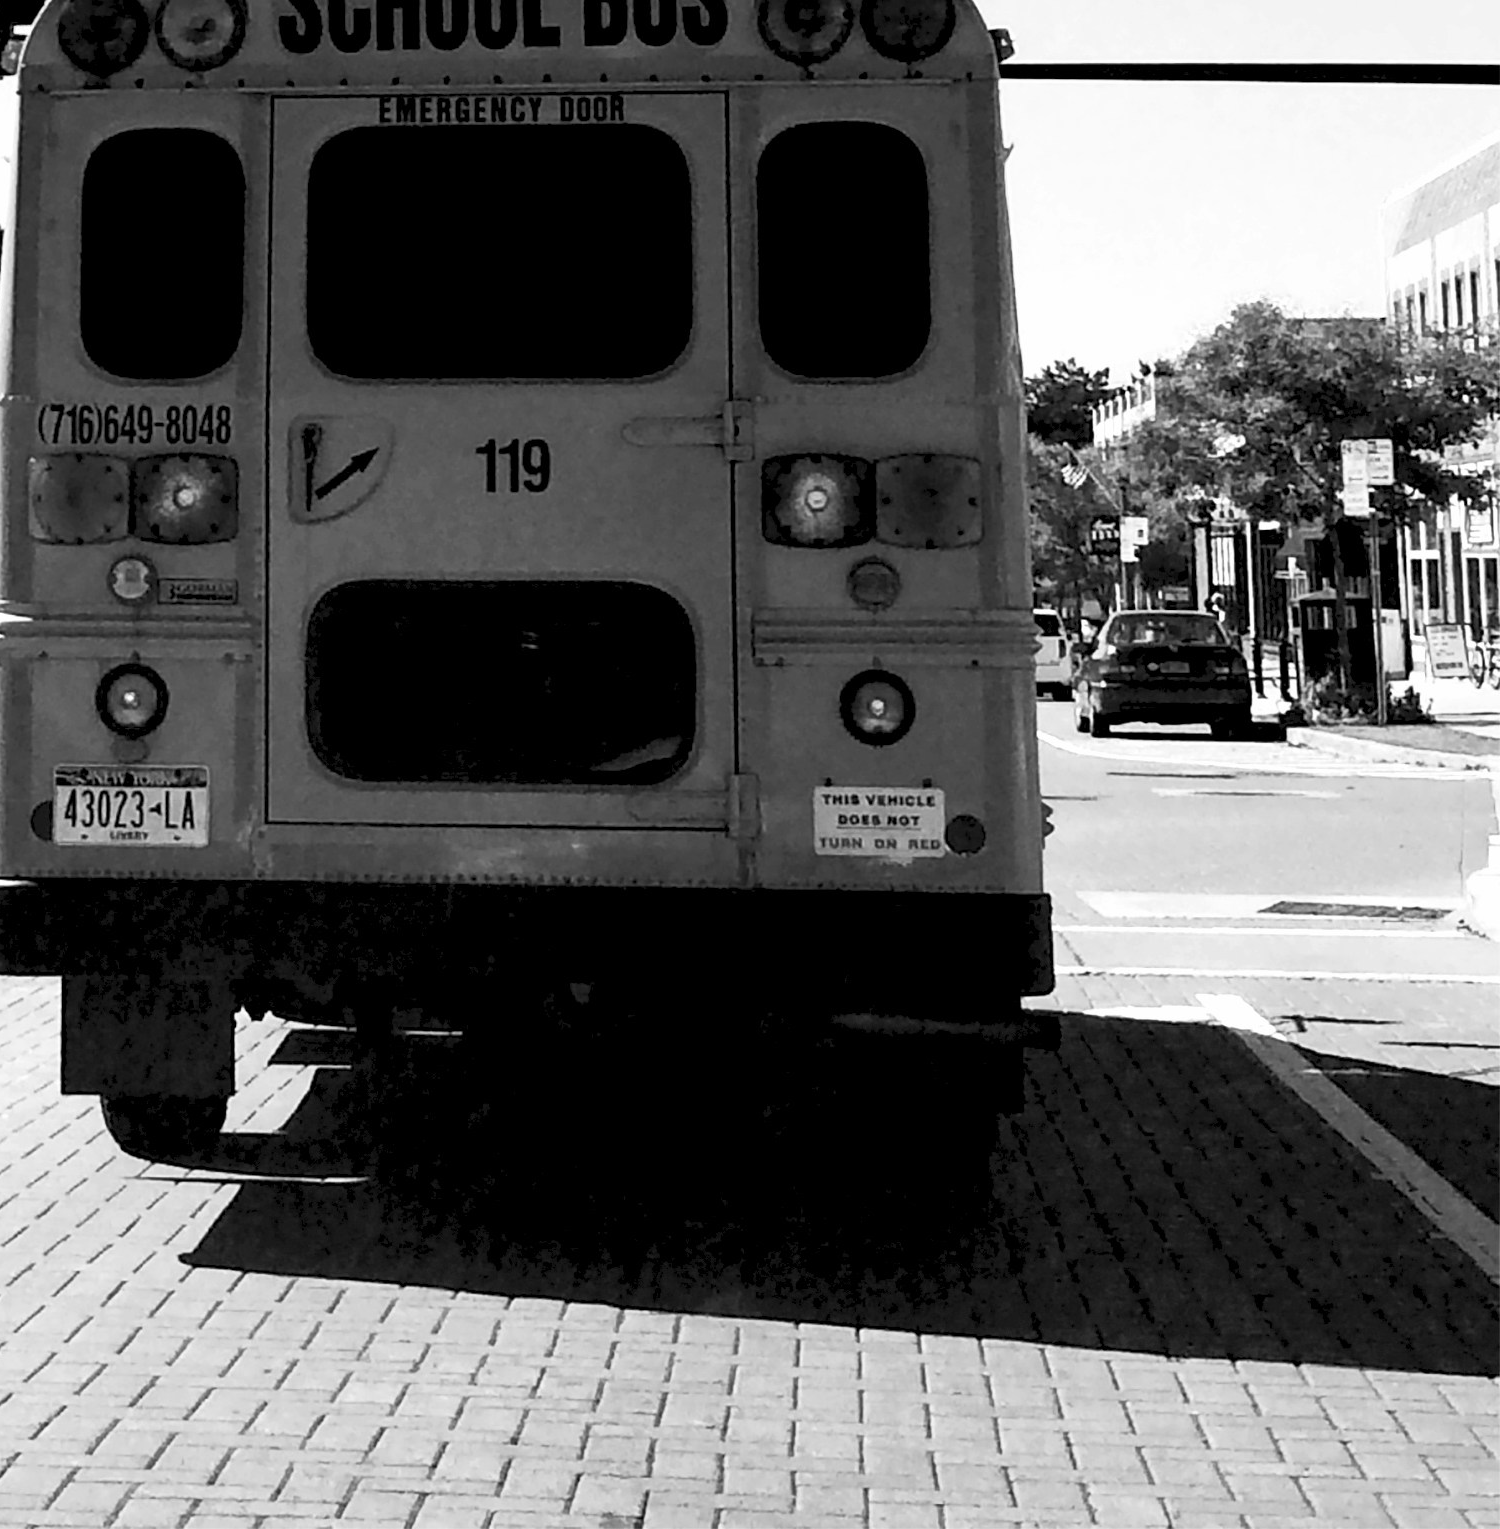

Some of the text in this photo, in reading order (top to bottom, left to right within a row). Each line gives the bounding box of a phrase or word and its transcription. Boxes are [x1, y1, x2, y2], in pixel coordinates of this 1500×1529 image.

[379, 94, 625, 123] EMERGENCY DOOR
[38, 403, 232, 445] (716)649-8048
[475, 438, 551, 493] 119
[821, 793, 936, 808] THIS VEHICLE
[838, 814, 920, 827] DOES NOT
[820, 837, 941, 851] TURN ON RED
